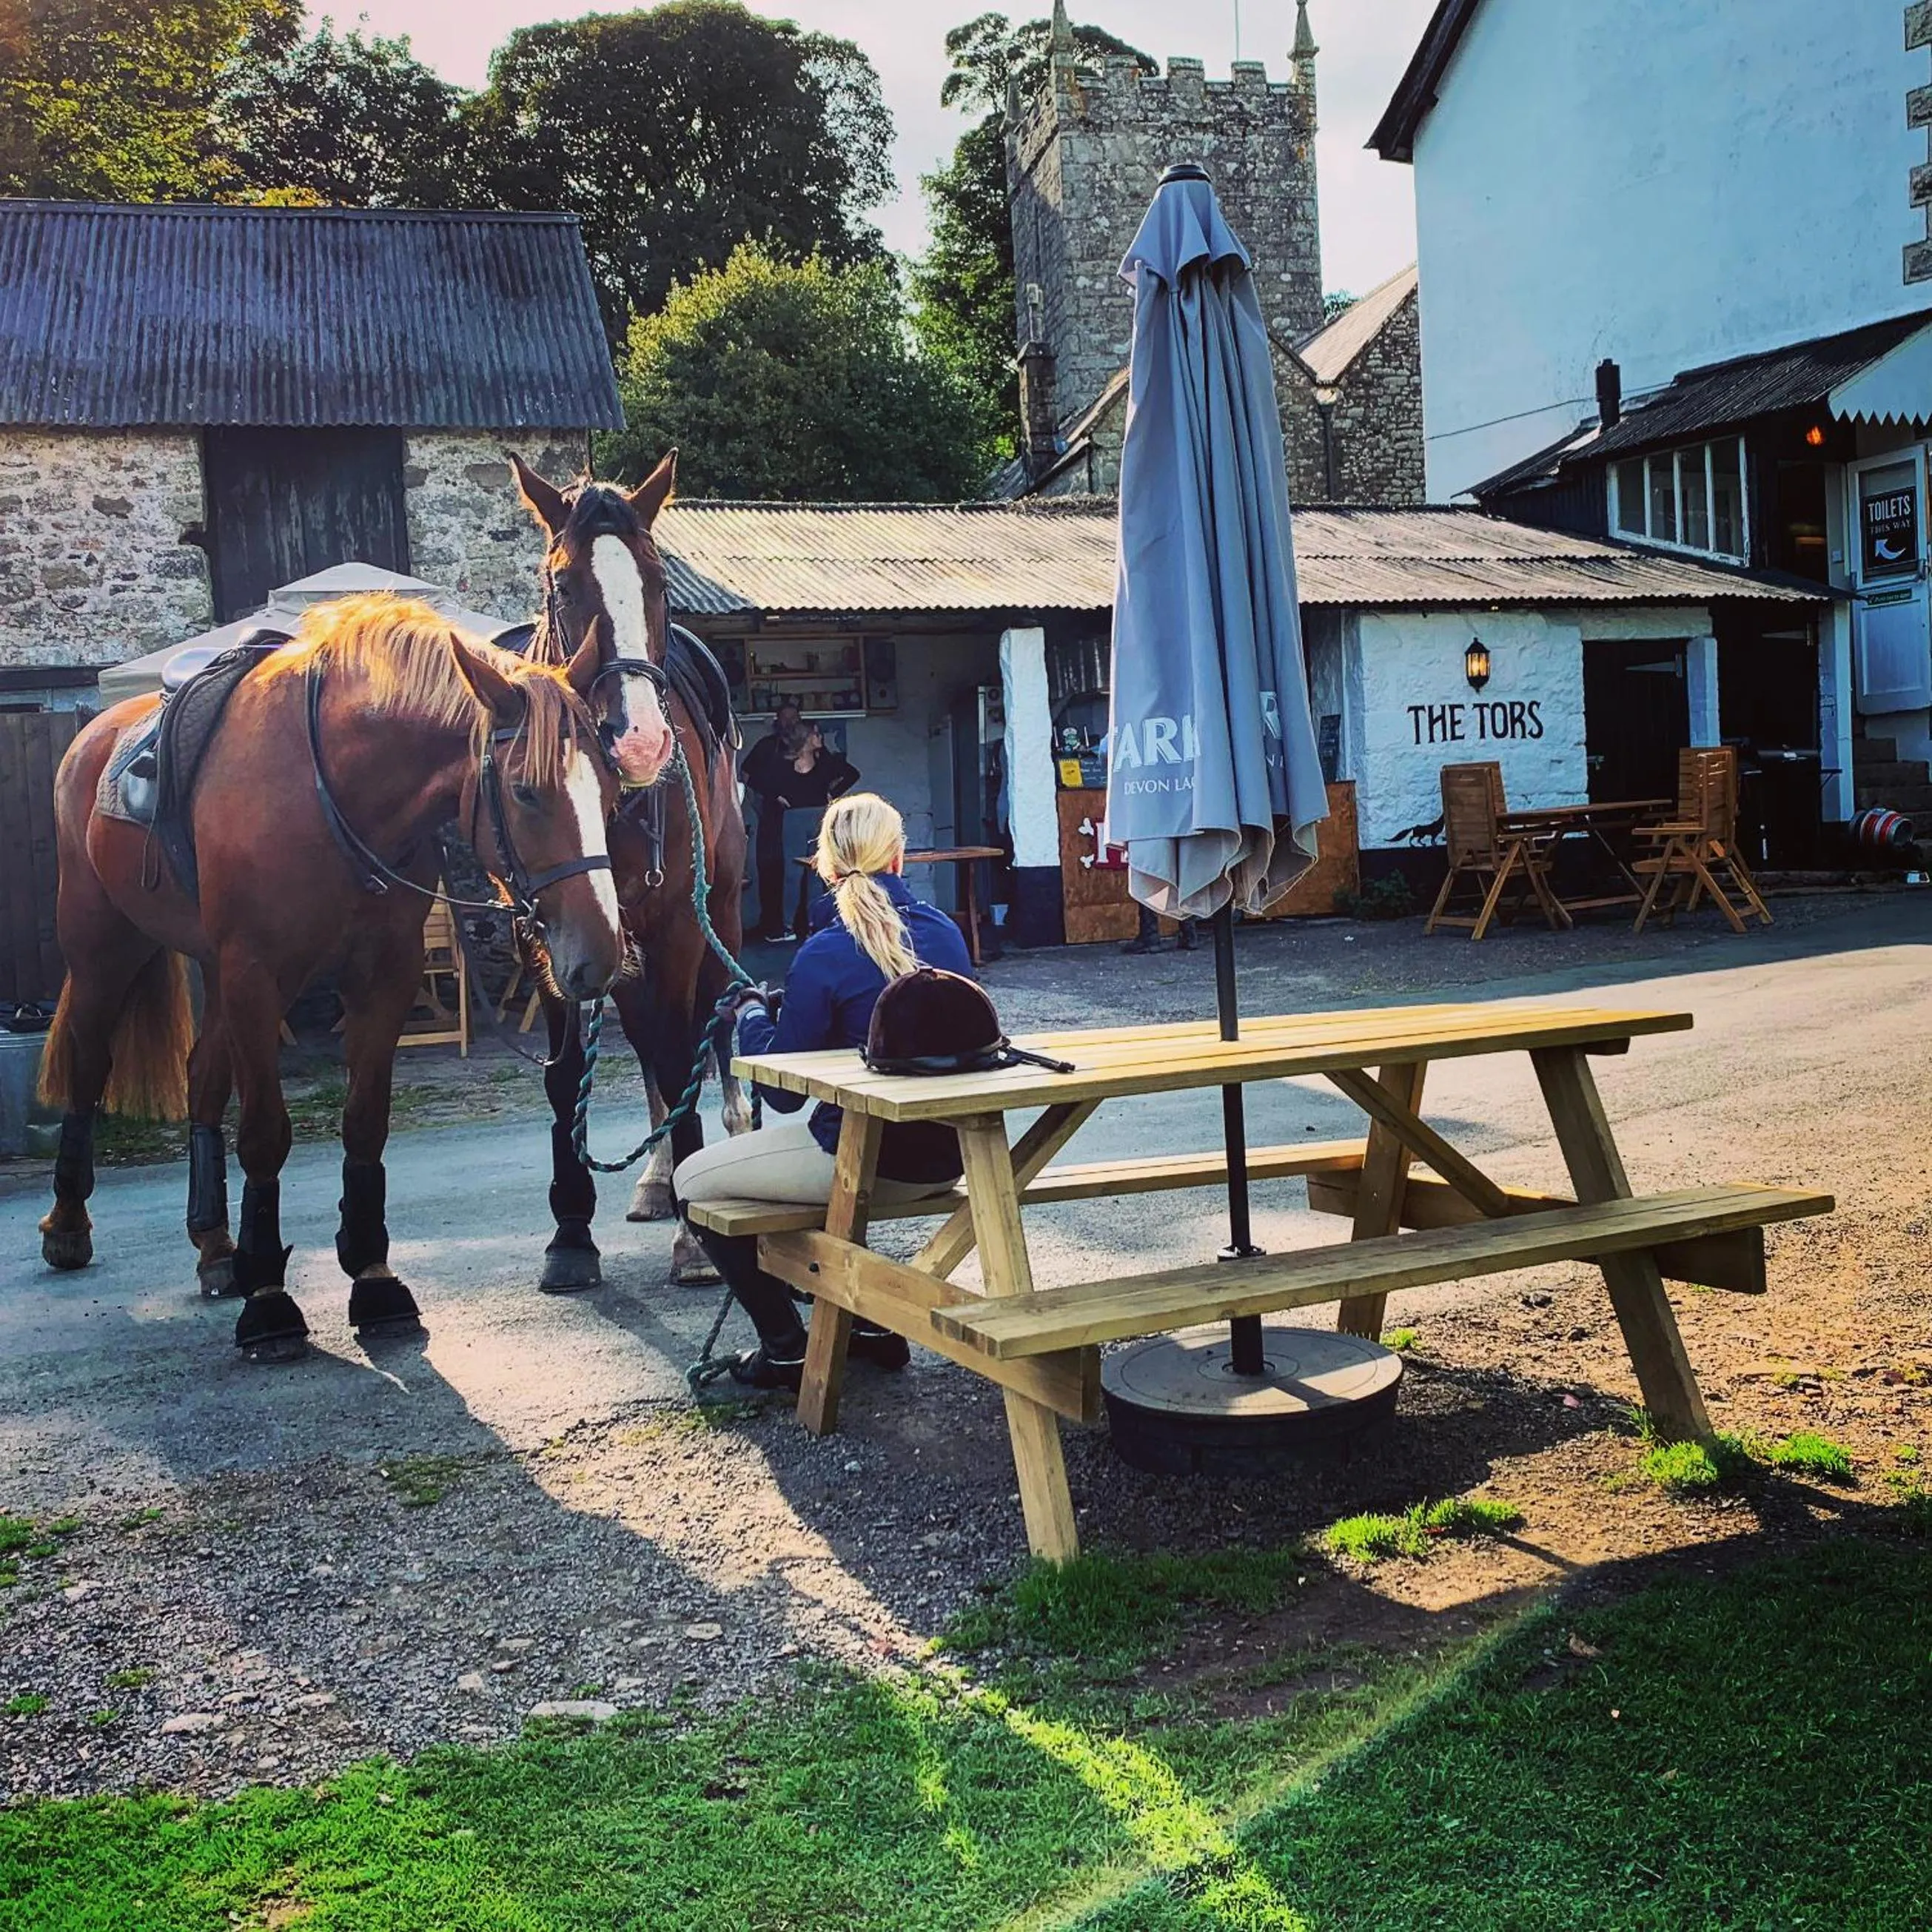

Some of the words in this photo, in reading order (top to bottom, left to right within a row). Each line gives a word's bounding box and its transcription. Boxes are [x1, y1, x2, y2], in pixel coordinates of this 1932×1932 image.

[1868, 495, 1911, 523] TOILETS
[1869, 524, 1890, 534] THIS
[1893, 519, 1910, 529] WAY
[1407, 704, 1465, 745] THE
[1472, 700, 1543, 739] TORS
[1124, 778, 1170, 795] DEVON
[1175, 776, 1195, 791] LA
